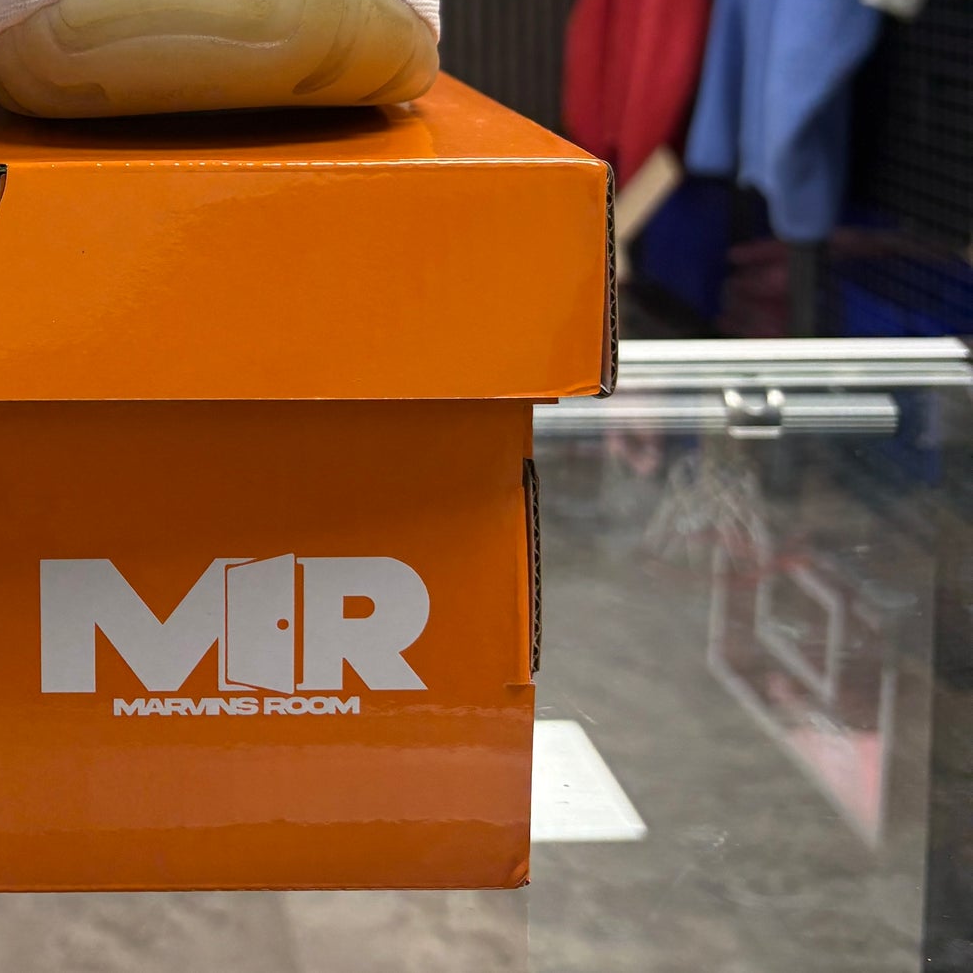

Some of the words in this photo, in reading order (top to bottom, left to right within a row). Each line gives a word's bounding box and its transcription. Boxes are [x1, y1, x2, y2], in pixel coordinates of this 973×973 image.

[40, 553, 431, 695] MR
[113, 697, 258, 716] MARVINS
[263, 696, 360, 715] ROOM
